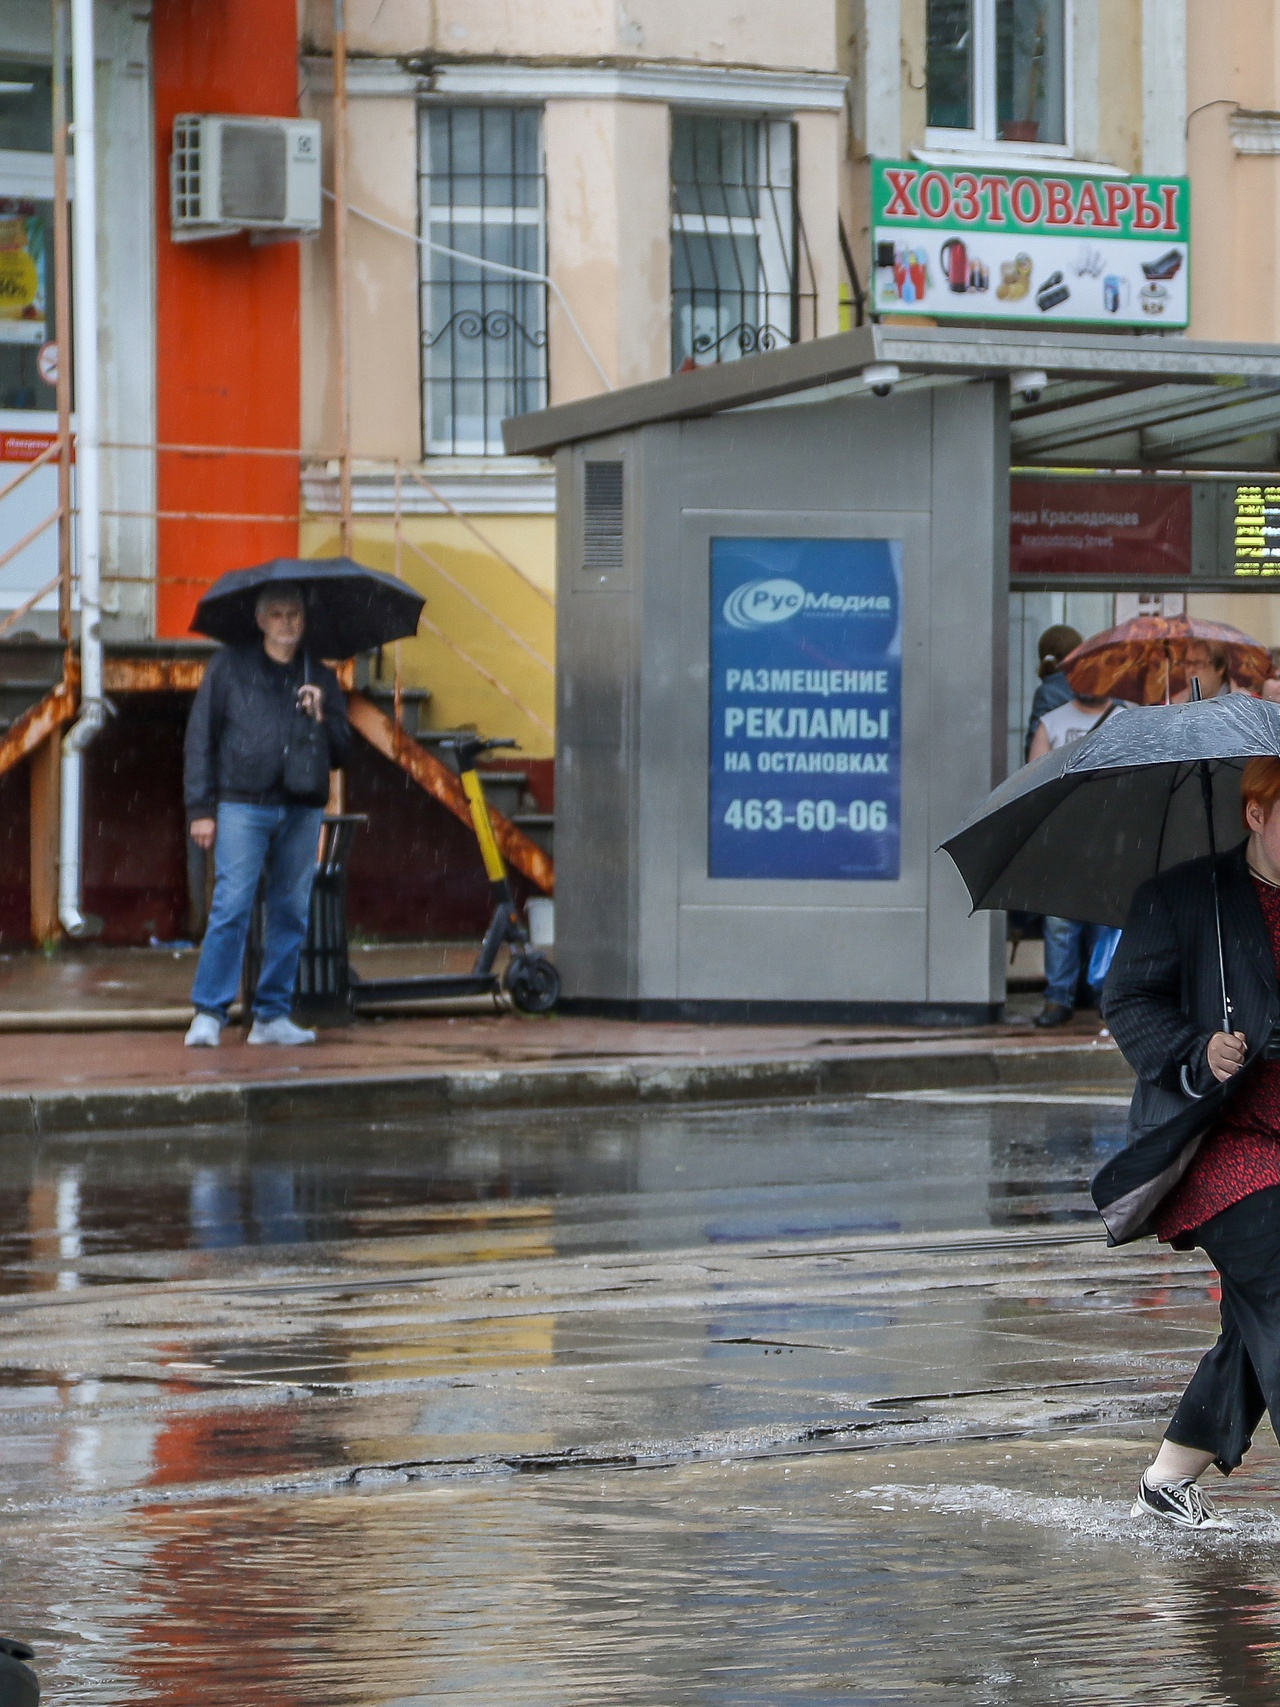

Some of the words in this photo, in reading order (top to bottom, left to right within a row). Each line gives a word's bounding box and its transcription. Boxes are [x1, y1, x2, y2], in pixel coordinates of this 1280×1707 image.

[883, 169, 1179, 231] ХОЗТОВАРЫ
[726, 668, 888, 697] РАЗМЕЩЕНИЕ
[724, 707, 889, 740] РЕКЛАМЫ
[724, 751, 751, 773] НА
[757, 751, 889, 774] ОСТАНОВКАХ
[723, 798, 888, 832] 463-60-06
